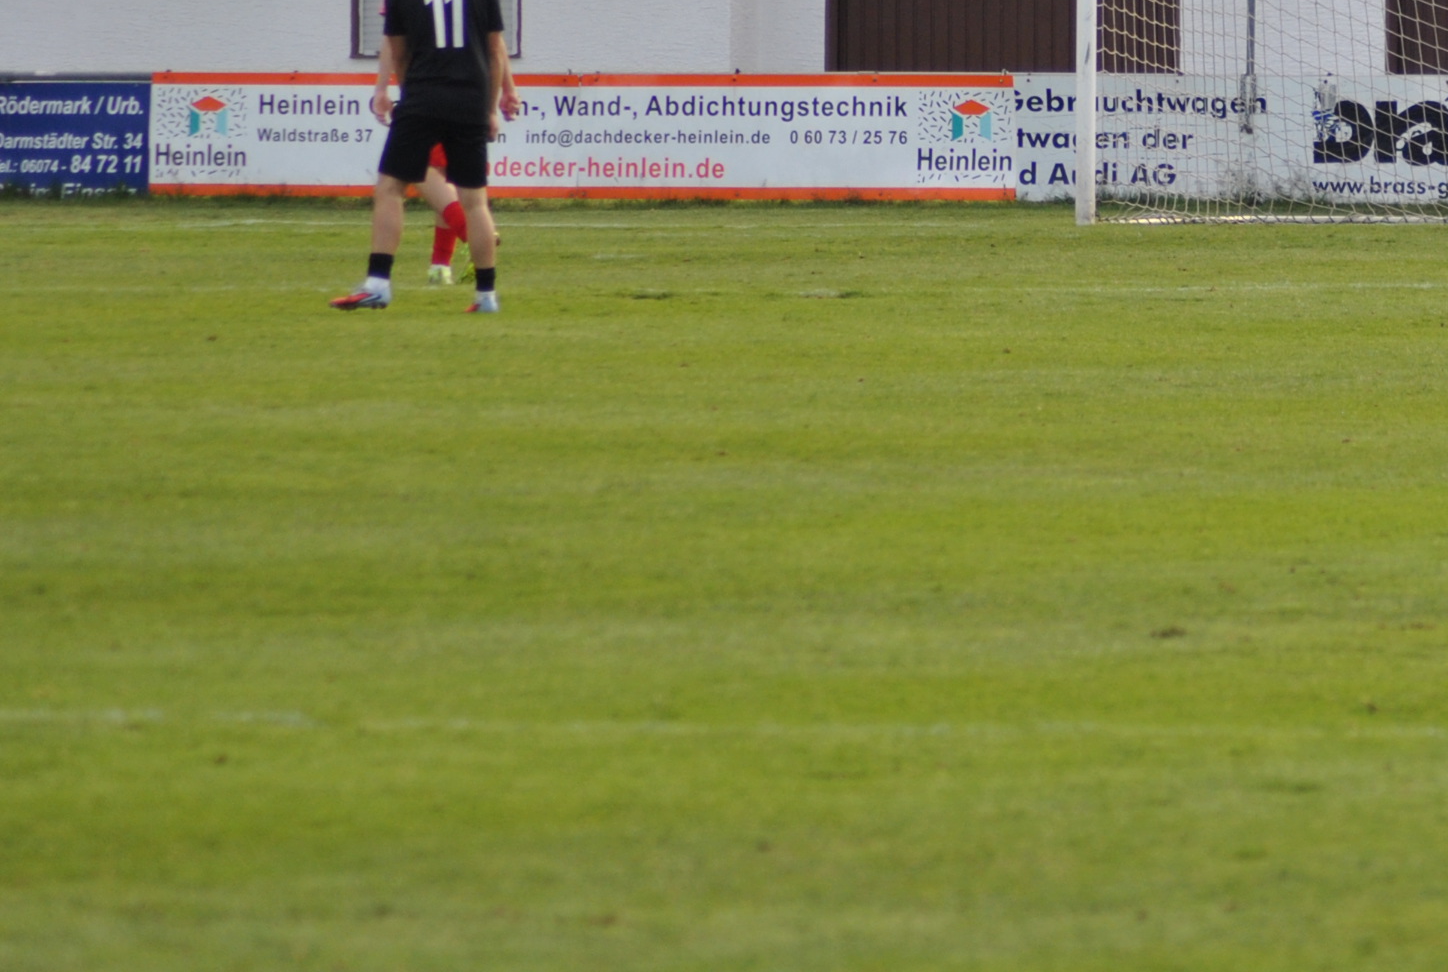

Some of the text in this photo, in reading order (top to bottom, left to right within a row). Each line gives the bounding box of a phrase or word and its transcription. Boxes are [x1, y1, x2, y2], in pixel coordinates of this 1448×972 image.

[106, 96, 144, 115] Urb.
[258, 94, 360, 115] Heinlein
[554, 95, 638, 120] Wand-,
[645, 95, 908, 122] Abdichtungstechnik
[1014, 88, 1267, 119] ebruchtwagen
[91, 132, 119, 149] Str.
[123, 133, 143, 149] 34
[257, 128, 373, 143] Waldstraße 37
[525, 130, 771, 147] info@dachdecker-heinlein.de
[790, 131, 798, 144] 0
[804, 131, 822, 144] 60
[828, 131, 847, 144] 73
[863, 131, 883, 144] 25
[889, 131, 908, 145] 76
[1142, 129, 1193, 150] der
[0, 159, 18, 173] el.:
[20, 159, 59, 173] 06074
[70, 154, 92, 173] 84
[96, 155, 118, 174] 72
[123, 155, 142, 173] 11
[155, 143, 247, 167] Heinlein
[917, 148, 1012, 171] Heinlein
[1048, 162, 1117, 185] Adi
[1130, 163, 1178, 186] AG
